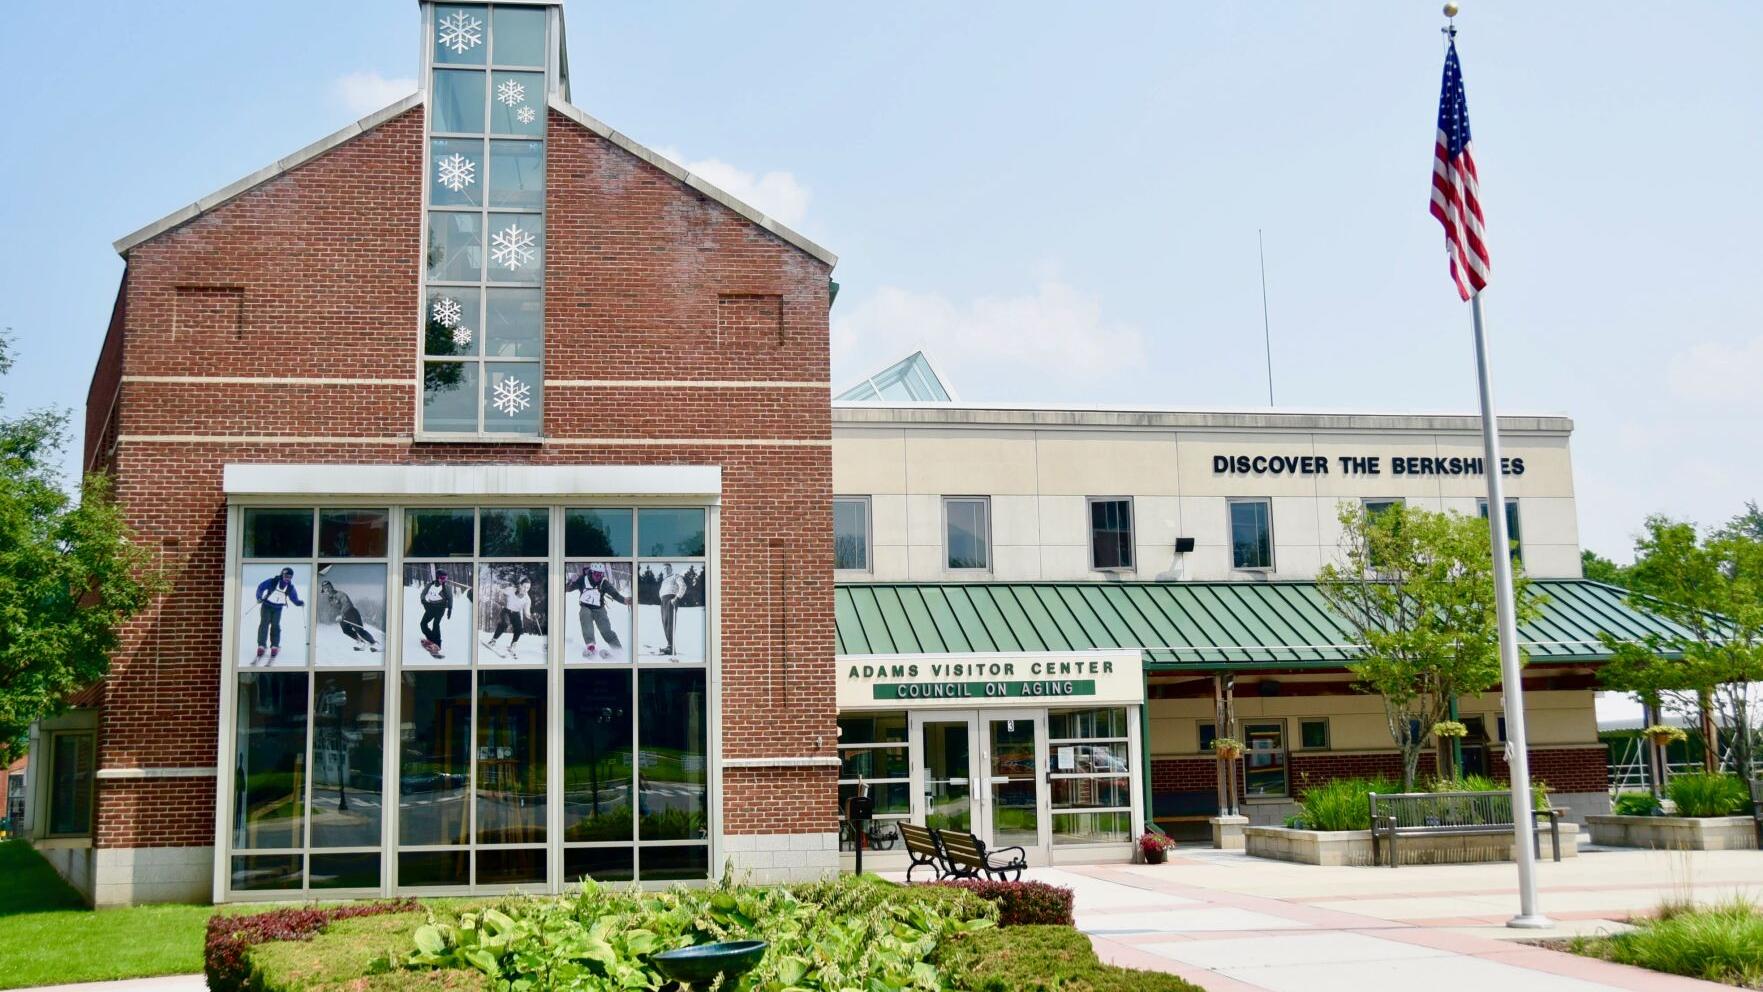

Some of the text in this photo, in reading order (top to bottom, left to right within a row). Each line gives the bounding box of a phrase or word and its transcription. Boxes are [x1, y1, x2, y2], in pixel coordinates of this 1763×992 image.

[1213, 455, 1525, 475] DISCOVER THE BERKSHIES
[849, 661, 1114, 678] ADAMS VISITOR CENTER
[897, 681, 1073, 698] COUNCIL ON AGING
